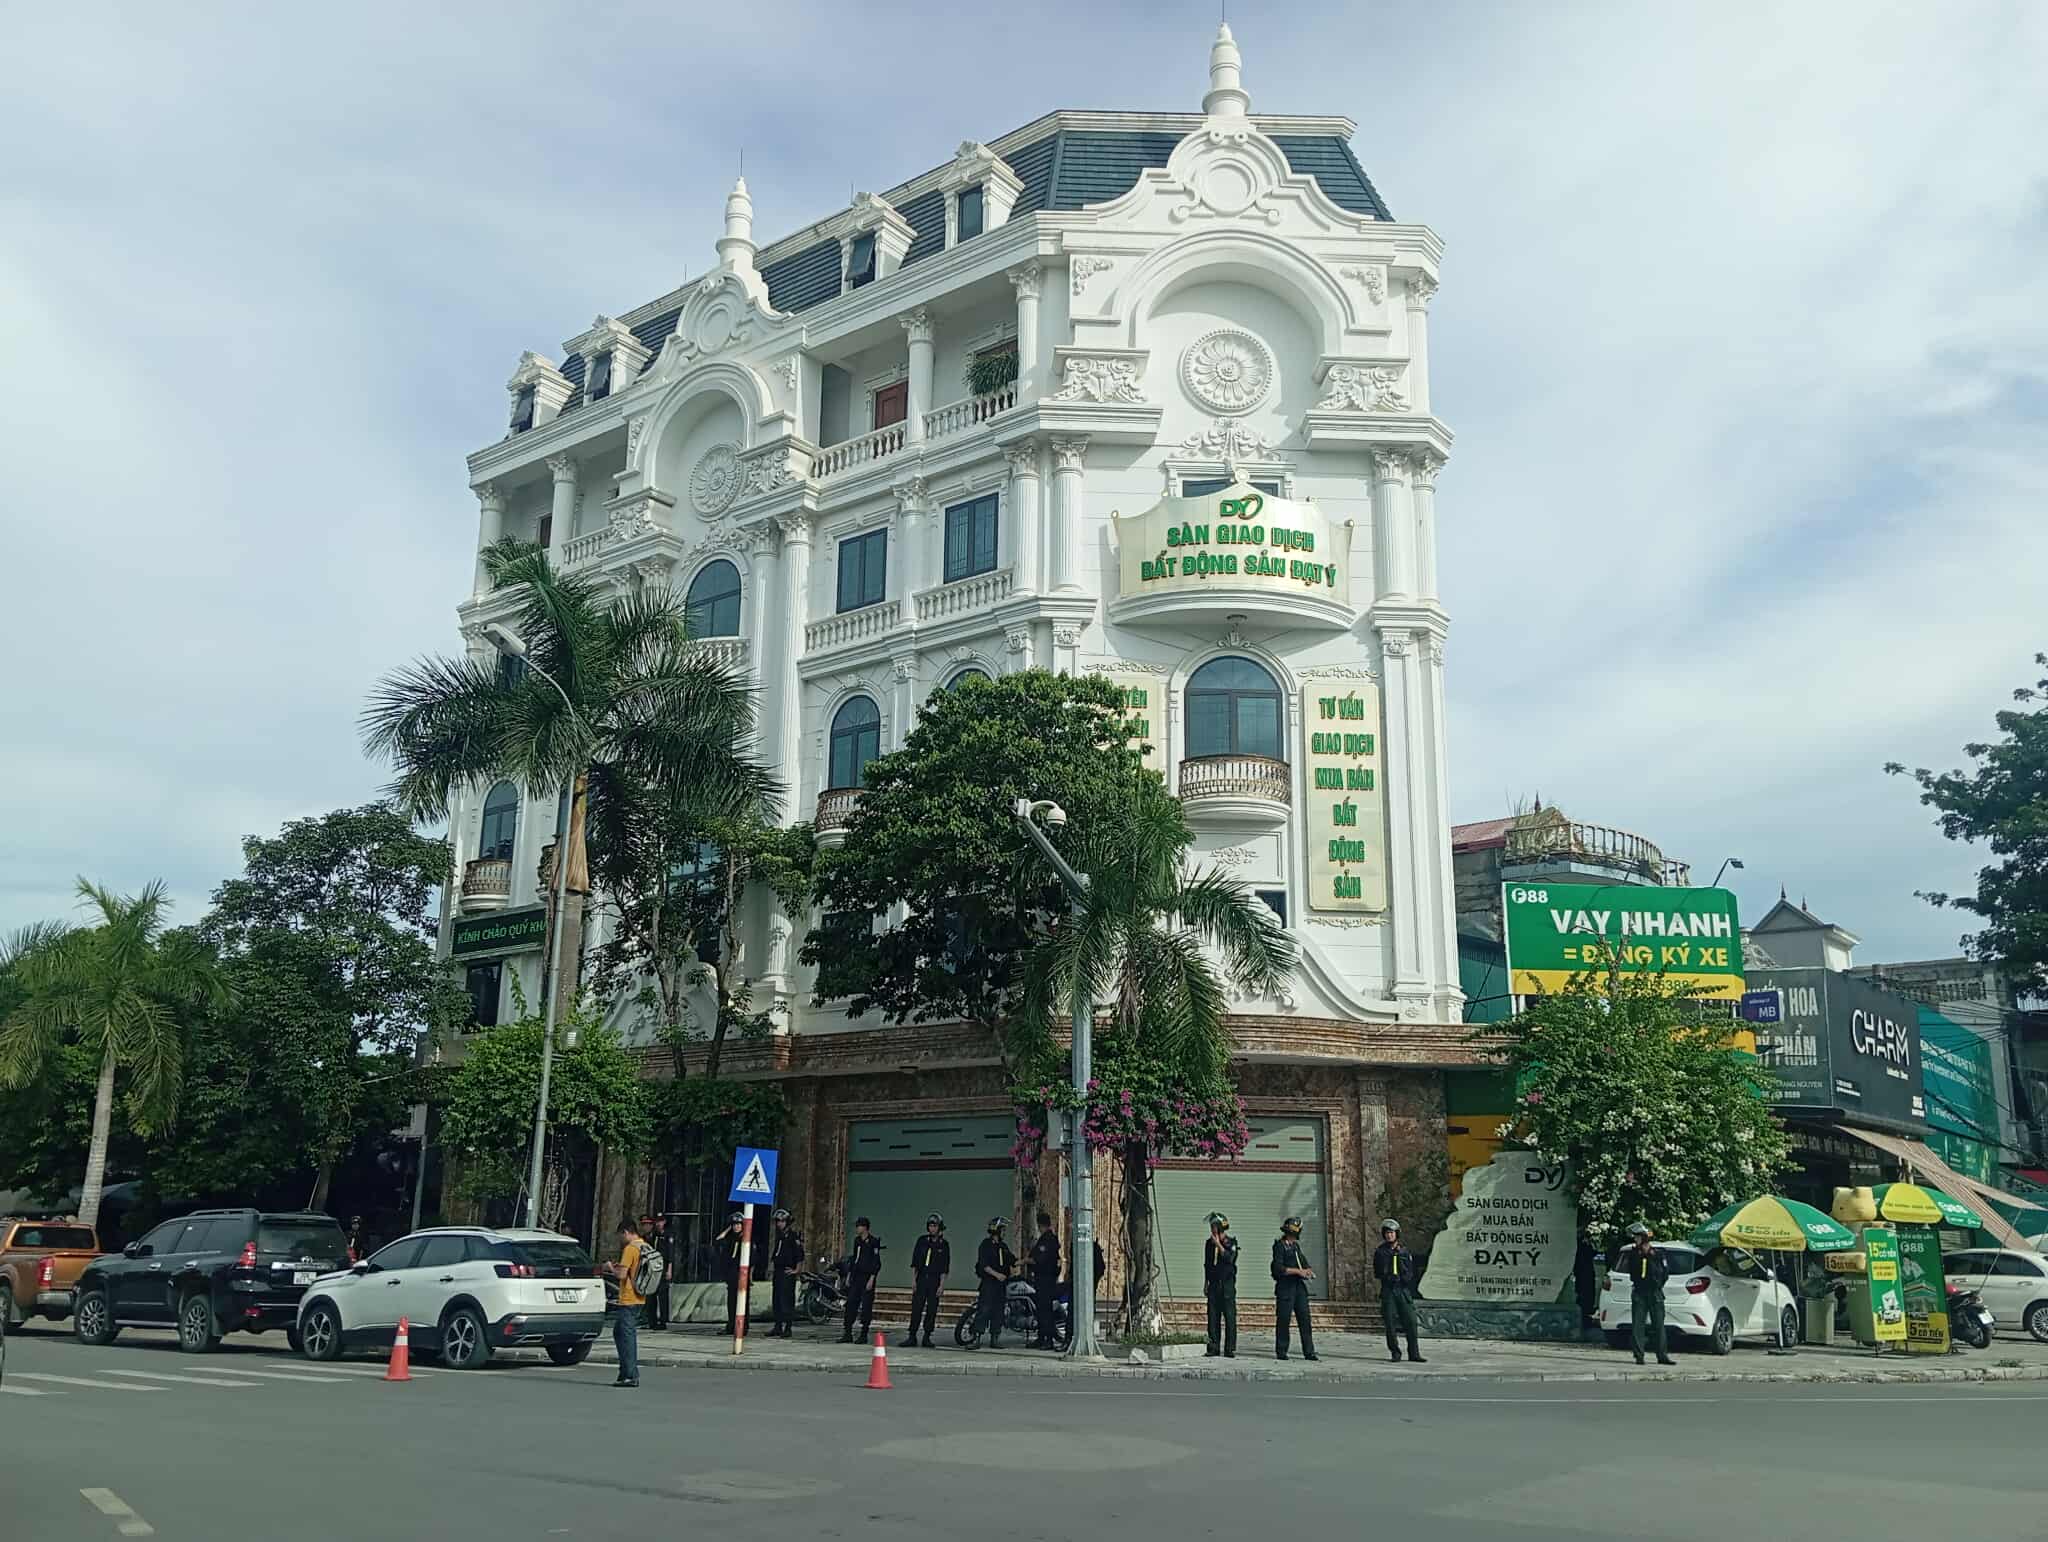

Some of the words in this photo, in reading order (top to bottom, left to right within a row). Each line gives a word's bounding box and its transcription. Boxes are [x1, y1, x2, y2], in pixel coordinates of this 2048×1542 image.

[1167, 522, 1209, 547] SÀN
[1216, 524, 1265, 545] GIAO
[1271, 526, 1314, 552] DỊCH
[1141, 550, 1176, 581] BẤT
[1182, 551, 1237, 578] ĐỘNG
[1244, 550, 1287, 577] SẢN
[1290, 559, 1324, 586] ĐẠT
[1319, 696, 1336, 719] TƯ
[1338, 690, 1364, 721] VẤN
[1312, 732, 1341, 755] GIAO
[1344, 734, 1375, 760] DỊCH
[1315, 767, 1344, 790] MUA
[1347, 764, 1374, 791] BÁN
[1333, 796, 1358, 826] BẤT
[1329, 836, 1365, 867] ĐỘNG
[1334, 869, 1361, 898] SẢN
[482, 923, 507, 940] CHÀO
[509, 918, 529, 939] QUÝ
[1550, 909, 1612, 935] VAY
[1620, 911, 1732, 938] NHANH
[1661, 942, 1691, 966] KÝ
[1700, 947, 1729, 967] XE
[1759, 1006, 1776, 1018] MB
[1788, 987, 1819, 1016] HOA
[1852, 1008, 1910, 1067] CHARM
[1467, 1196, 1490, 1209] SÀN
[1493, 1198, 1520, 1209] GIAO
[1522, 1199, 1549, 1212] DỊCH
[1483, 1215, 1509, 1226] MUA
[1511, 1213, 1534, 1226] BÁN
[1466, 1228, 1489, 1242] BẤT
[1491, 1230, 1522, 1246] ĐỘNG
[1474, 1249, 1522, 1269] ĐẠT
[1526, 1247, 1541, 1266] Ý
